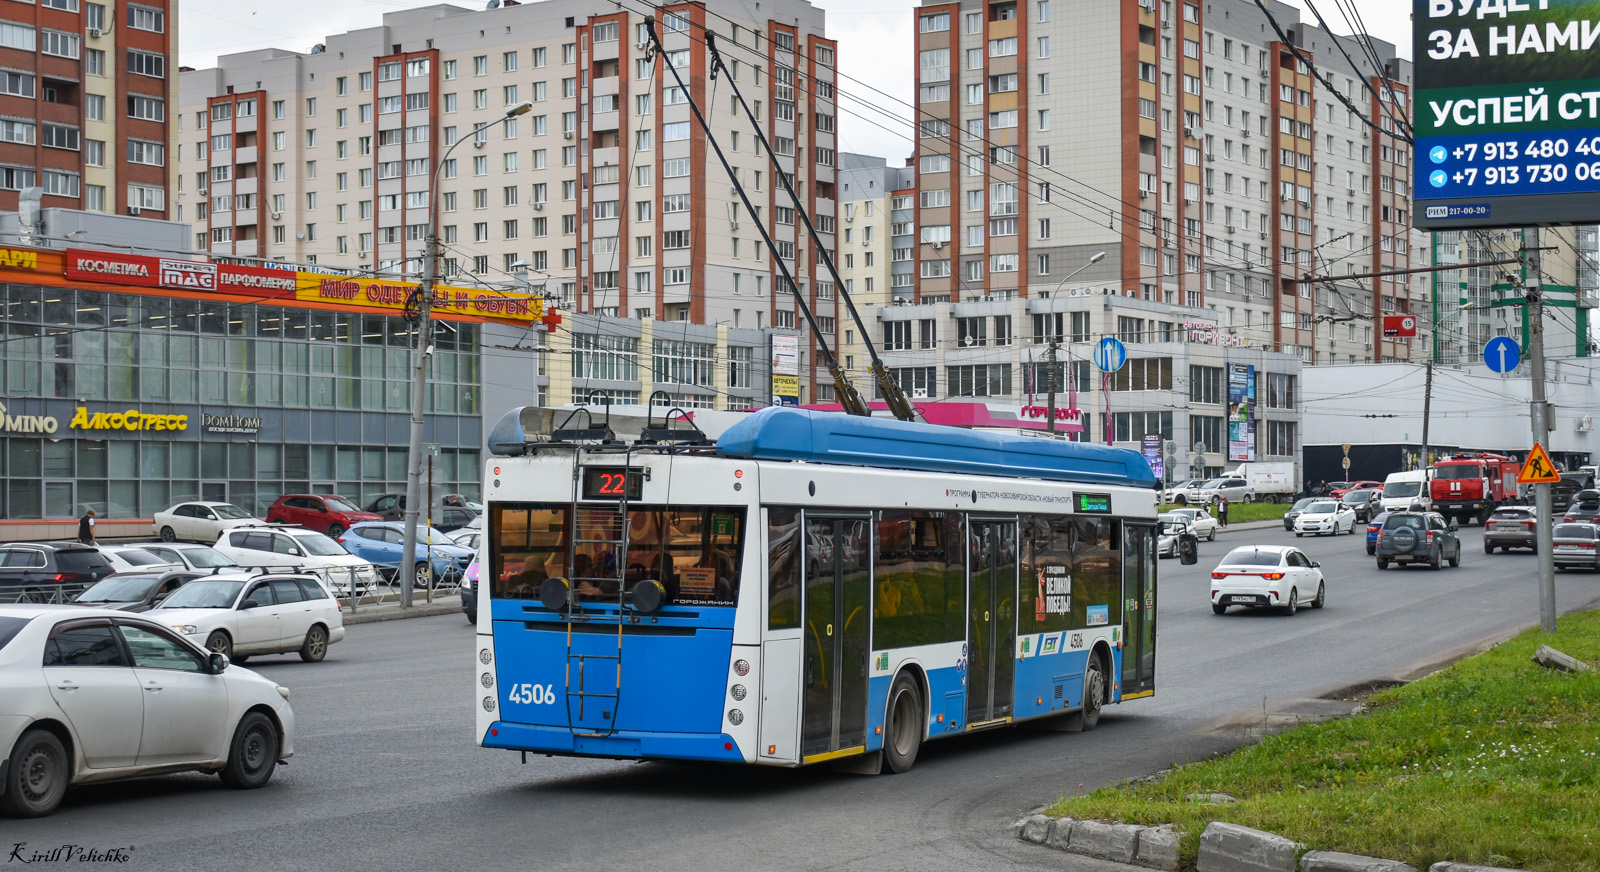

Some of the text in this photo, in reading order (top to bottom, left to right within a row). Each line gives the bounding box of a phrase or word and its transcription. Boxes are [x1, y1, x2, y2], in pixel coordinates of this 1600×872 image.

[1427, 20, 1600, 60] ЗА НАМИ
[1428, 87, 1549, 128] УСПЕЙ
[1452, 143, 1478, 162] +7
[1484, 141, 1519, 161] 913
[1524, 139, 1569, 158] 480
[1452, 168, 1478, 186] +7
[1484, 166, 1520, 185] 913
[1526, 163, 1568, 183] 730
[1427, 206, 1486, 217] РИМ 217-00-20
[77, 258, 149, 277] КОСМЕТИКА
[220, 273, 295, 291] ПАРФЮМЕРИЯ
[320, 278, 530, 315] МИР ОДЕЖЫ И ОБУВИ
[1404, 320, 1412, 328] 15
[599, 473, 626, 494] 22
[949, 489, 971, 498] ПРОГРАММА
[1046, 575, 1071, 595] ВЕЛИКОЙ
[1046, 595, 1071, 615] ПОБЕДЫ!
[1070, 633, 1084, 649] 4506
[508, 683, 556, 705] 4506
